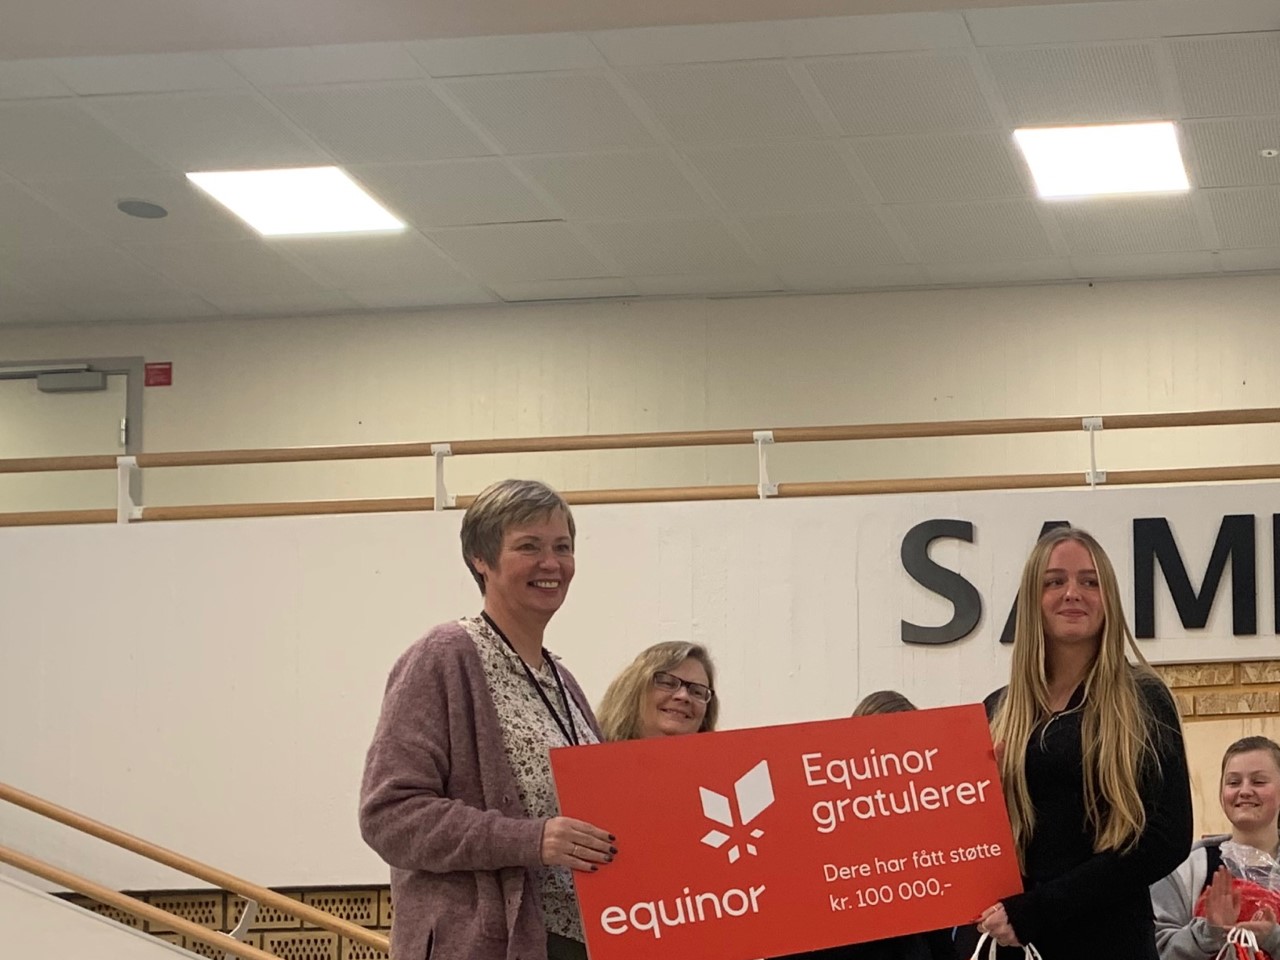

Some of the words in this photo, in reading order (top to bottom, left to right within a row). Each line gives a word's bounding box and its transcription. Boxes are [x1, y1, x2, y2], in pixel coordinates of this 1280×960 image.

[802, 748, 938, 790] Equinor
[812, 779, 991, 833] gratulerer
[823, 863, 871, 882] Dere
[875, 857, 907, 874] har
[912, 850, 946, 868] fått
[949, 843, 1001, 863] støtte
[600, 884, 766, 939] equinor
[829, 894, 853, 911] kr.
[856, 885, 893, 908] 100
[898, 878, 952, 901] 000,-
